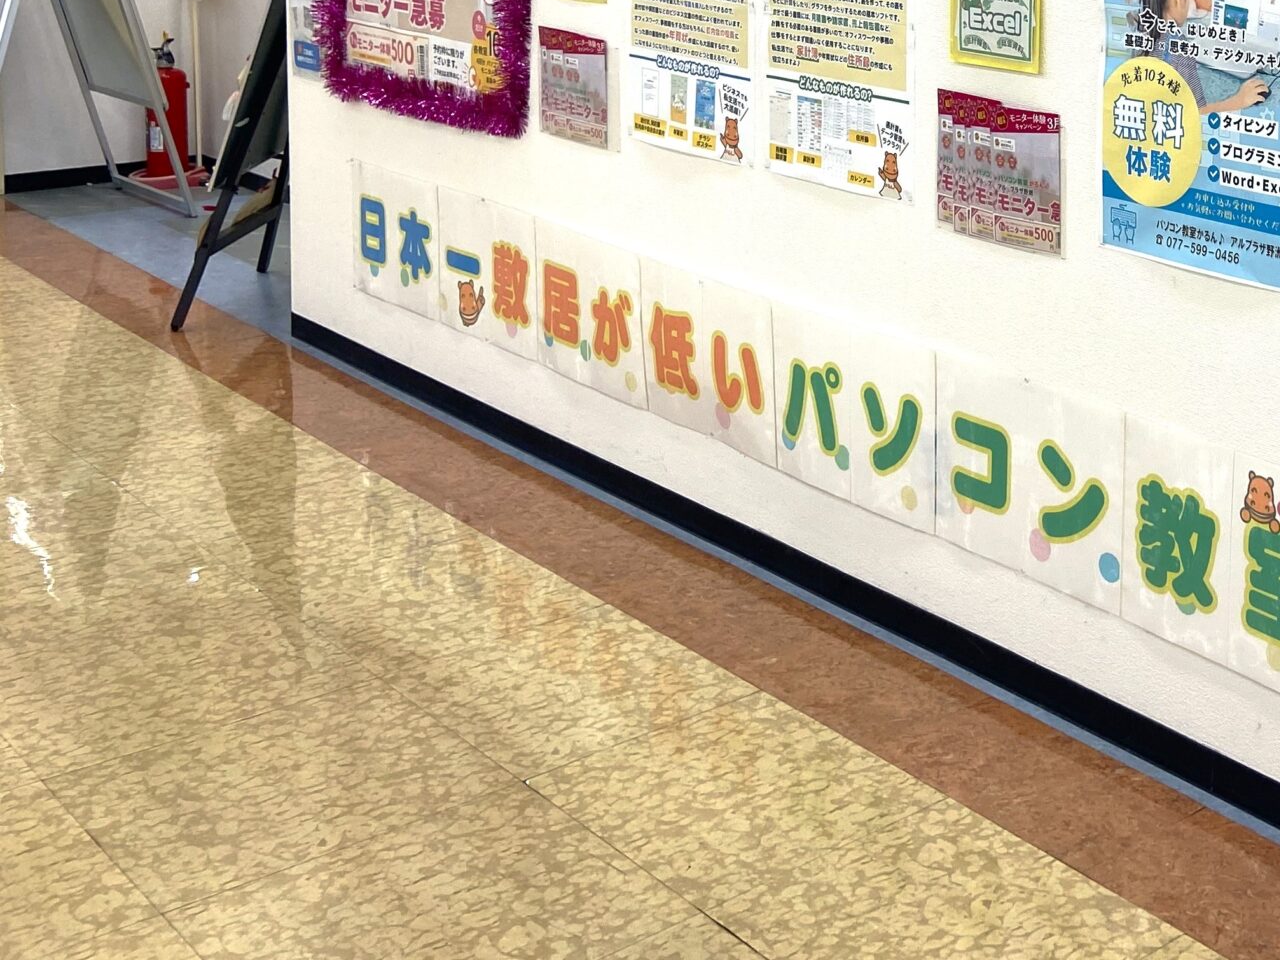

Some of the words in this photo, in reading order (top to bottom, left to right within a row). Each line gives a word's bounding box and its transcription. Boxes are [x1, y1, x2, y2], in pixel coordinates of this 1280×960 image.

[968, 6, 1022, 37] Excel
[1120, 65, 1182, 97] 先着10名様
[1113, 94, 1185, 149] 無料
[1222, 114, 1277, 136] タイピング
[1125, 145, 1172, 183] 体験
[1166, 236, 1240, 265] 077-599-0456
